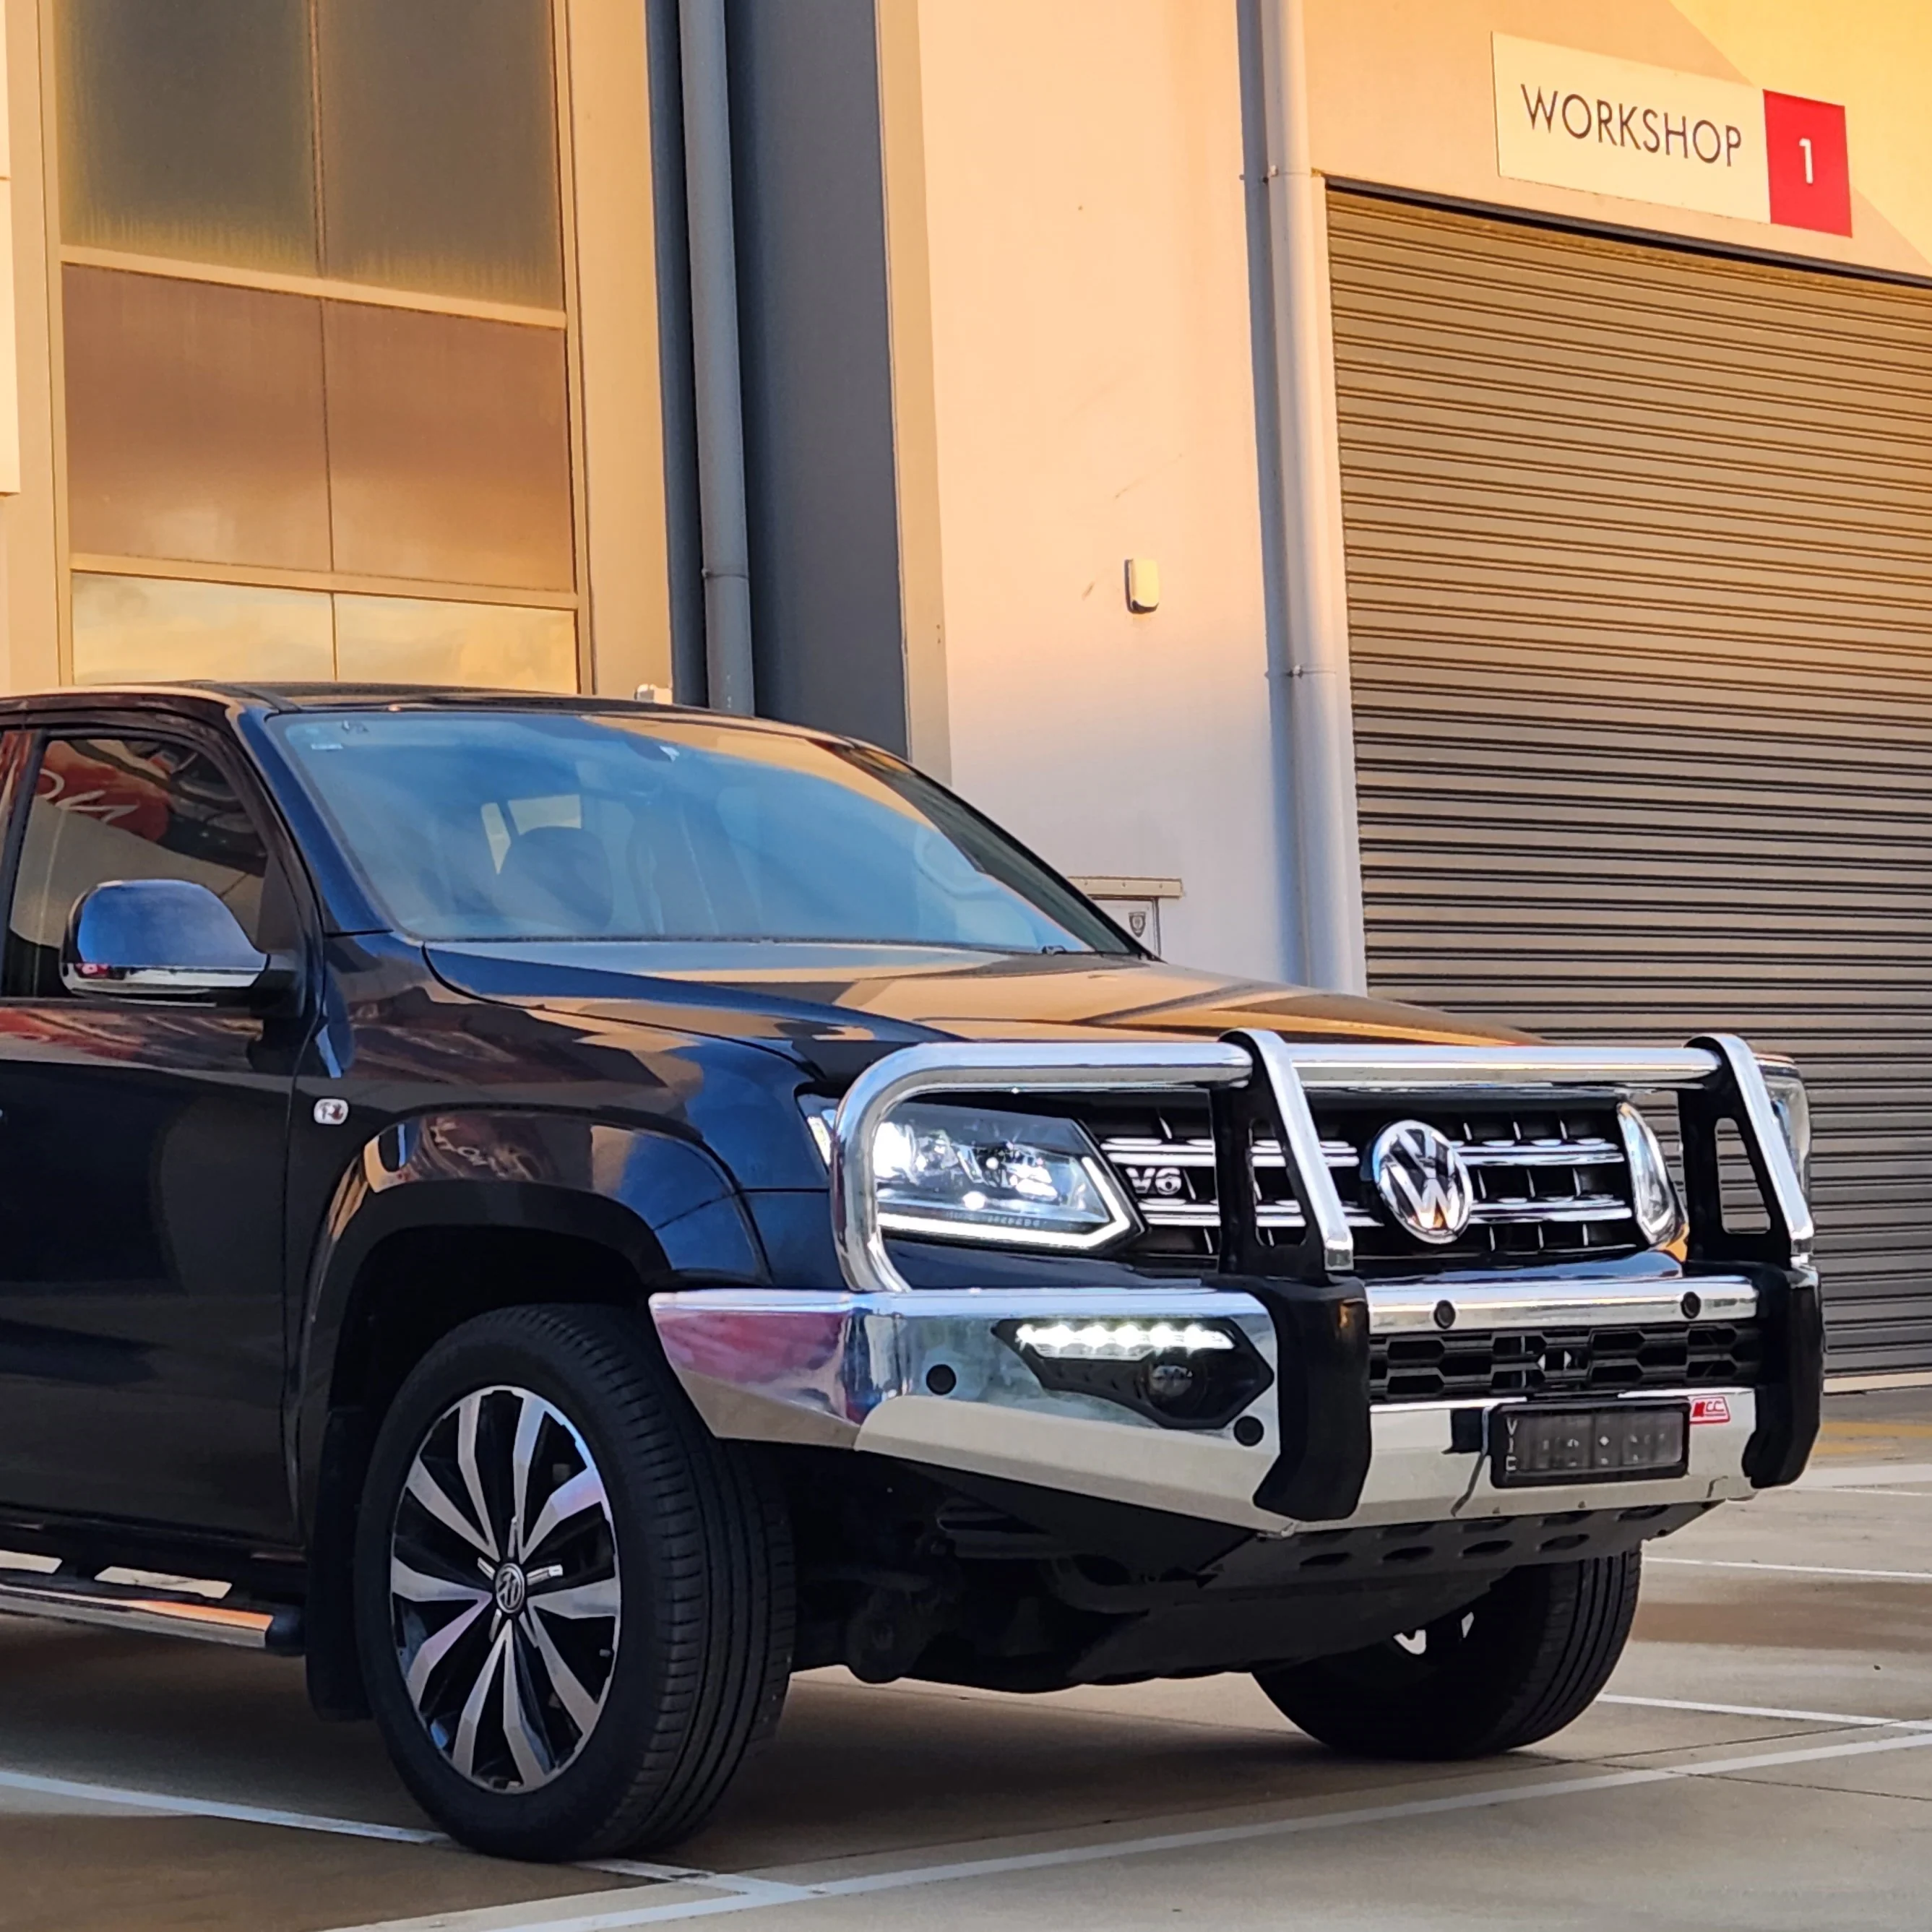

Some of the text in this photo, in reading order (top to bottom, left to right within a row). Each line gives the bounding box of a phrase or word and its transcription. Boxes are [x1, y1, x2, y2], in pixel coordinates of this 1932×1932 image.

[1521, 83, 1814, 184] WORKSHOP 1
[1126, 1167, 1181, 1195] V6
